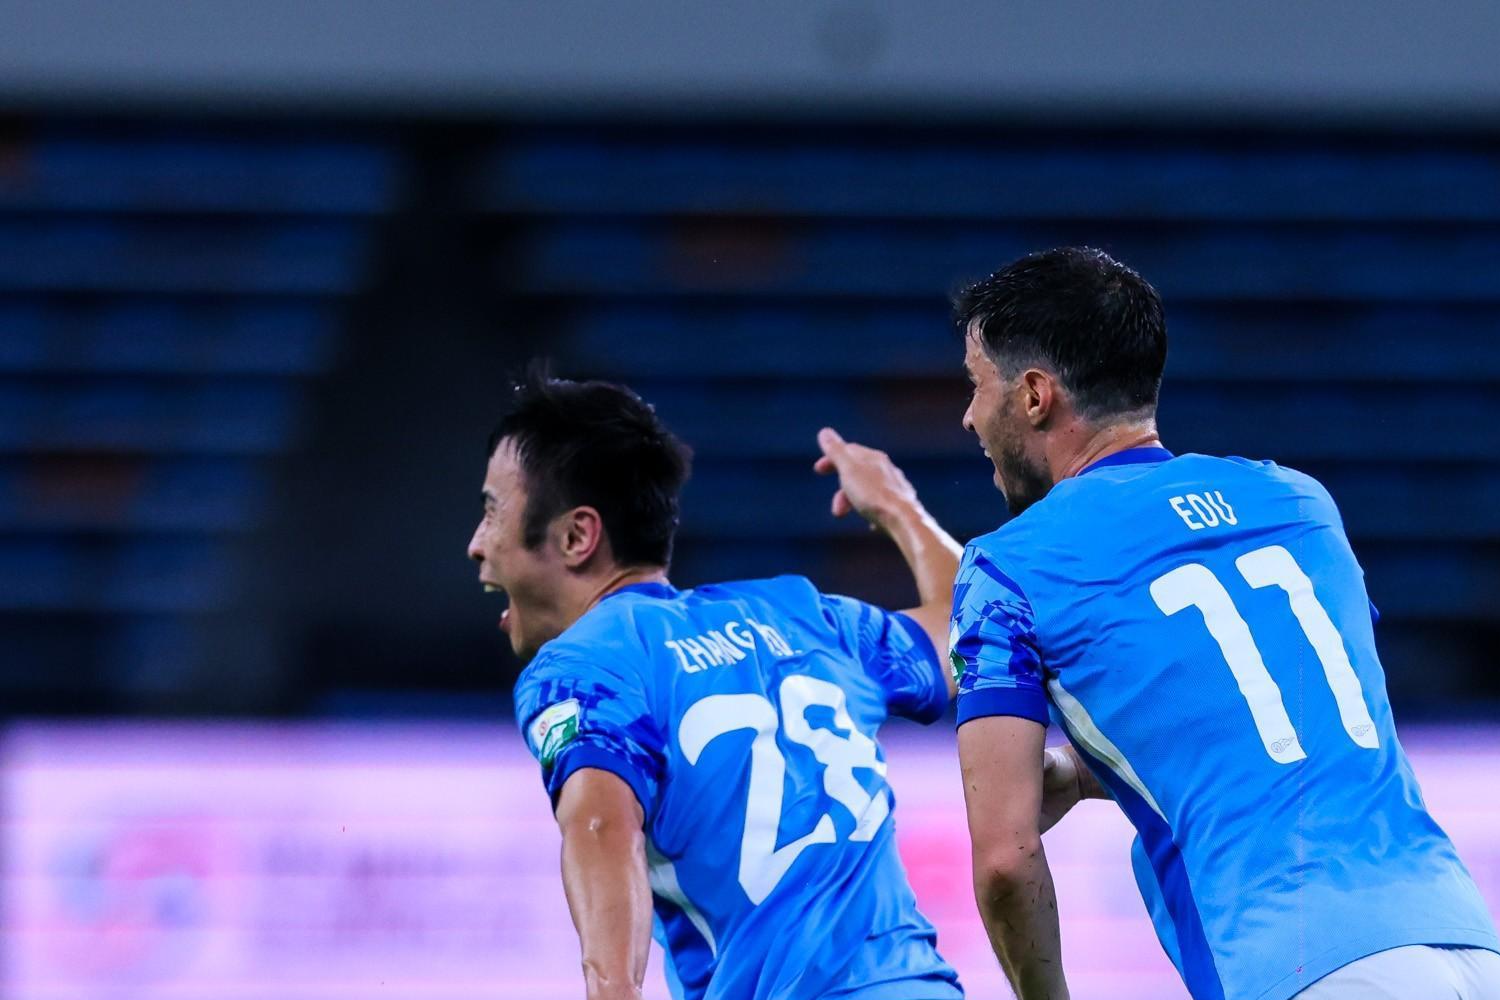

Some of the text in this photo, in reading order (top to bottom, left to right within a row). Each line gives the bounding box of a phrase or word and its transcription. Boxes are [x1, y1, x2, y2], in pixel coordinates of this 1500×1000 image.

[1168, 490, 1238, 531] EDU
[664, 620, 757, 674] ZHANG
[1148, 544, 1380, 765] 11
[677, 674, 890, 907] 28
